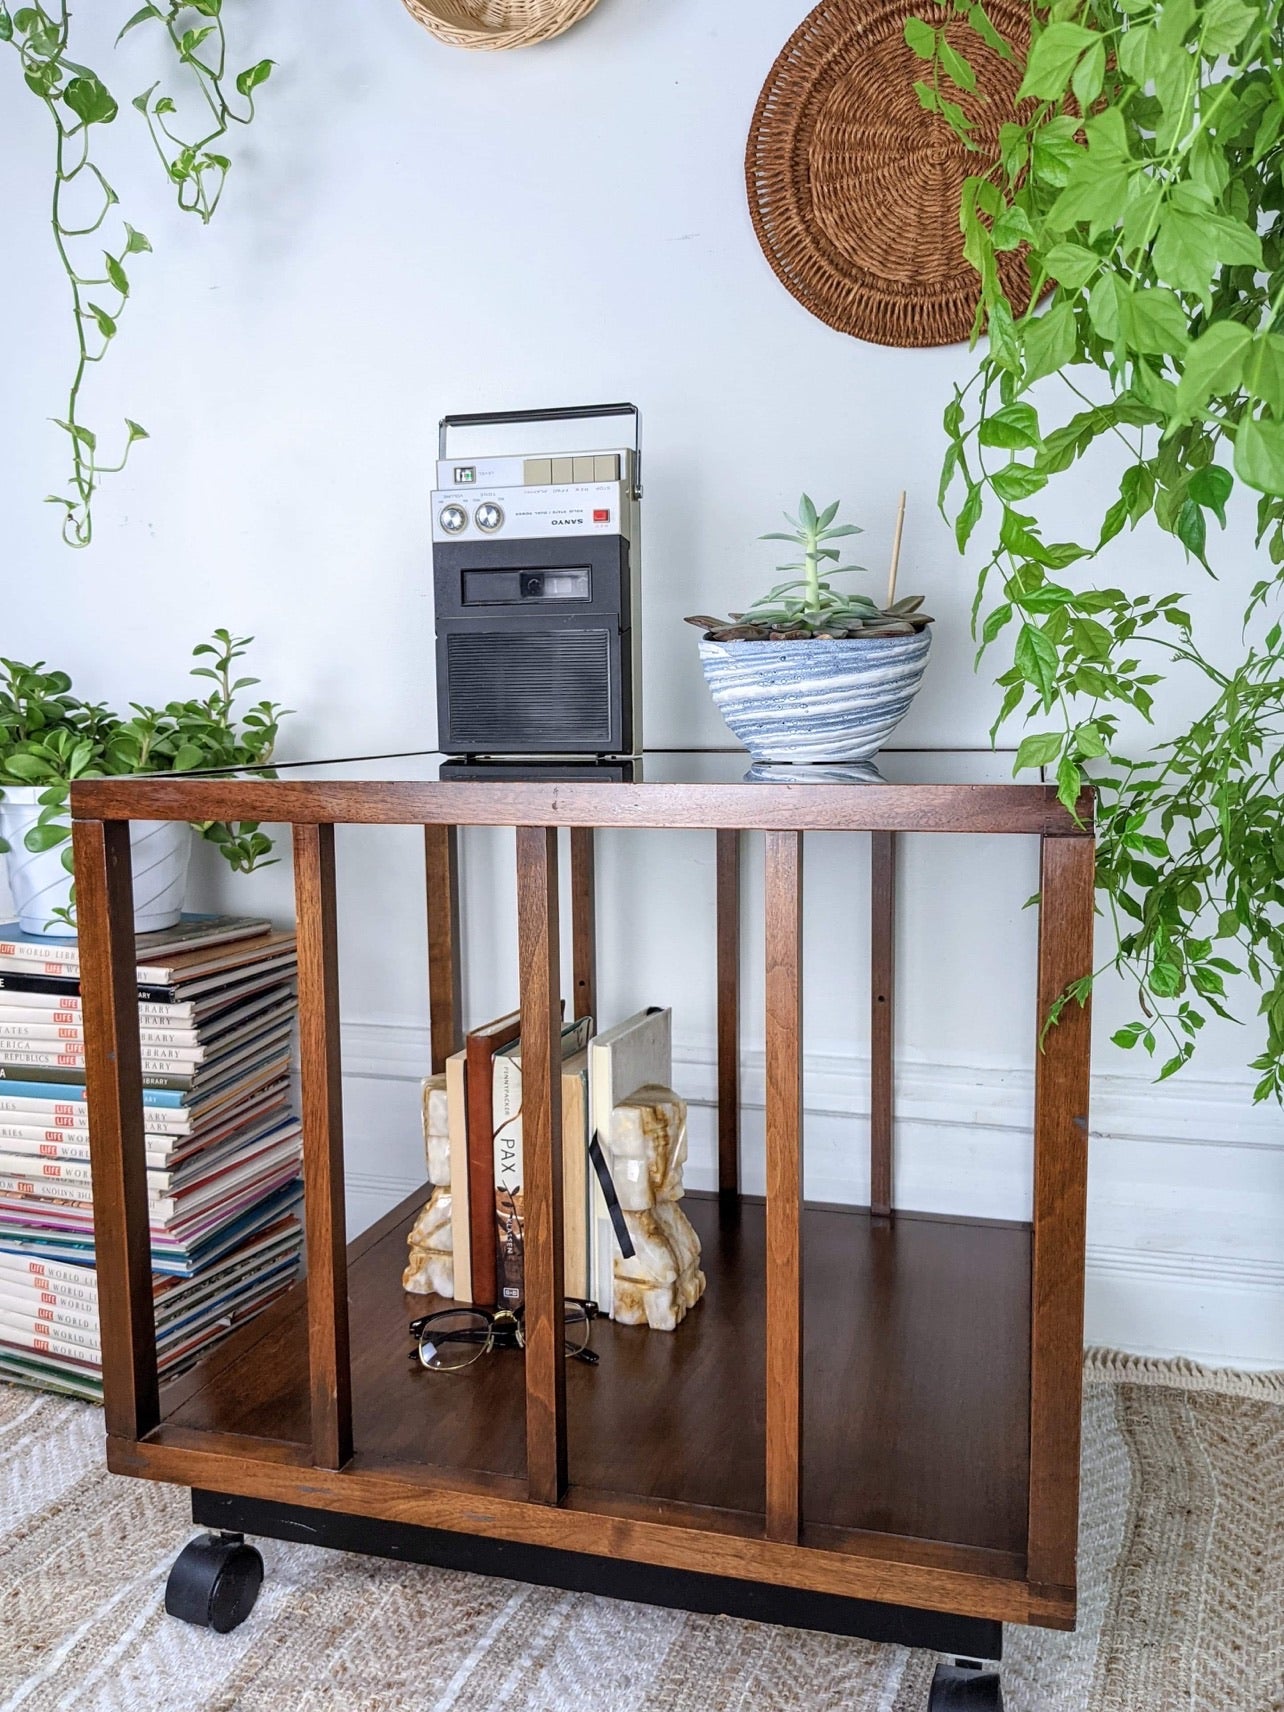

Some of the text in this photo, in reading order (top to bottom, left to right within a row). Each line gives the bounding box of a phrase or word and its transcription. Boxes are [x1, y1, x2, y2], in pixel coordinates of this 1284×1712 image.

[0, 944, 75, 960] LIFE WORLD LIBR
[45, 962, 62, 974] LIFE
[61, 999, 78, 1009] LIFE
[54, 1013, 73, 1023] LIFE
[59, 1028, 78, 1038] LIFE
[141, 1033, 175, 1043] BRARY
[0, 1040, 31, 1049] ERICA
[65, 1043, 84, 1053] LIFE
[4, 1053, 171, 1071] REPUBLICS LIFE RARY
[503, 1066, 511, 1116] PENNYPACKER
[55, 1104, 74, 1115] LIFE
[55, 1116, 74, 1127] LIFE
[2, 1129, 23, 1137] RIES
[45, 1131, 64, 1142] LIFE
[39, 1144, 89, 1157] LIFE WORL
[500, 1137, 516, 1174] PAX
[43, 1165, 88, 1178] LIFE WOR
[18, 1182, 34, 1194] LIFE
[41, 1187, 74, 1198] NATIONS
[29, 1262, 45, 1275] LIFE
[48, 1268, 79, 1282] WORLD
[34, 1277, 50, 1290] LIFE
[53, 1284, 83, 1297] WORLD
[41, 1292, 92, 1312] LIFE WORLD
[38, 1308, 54, 1321] LIFE
[57, 1313, 89, 1328] WORLD
[34, 1322, 50, 1335] LIFE
[53, 1329, 85, 1343] WORLD
[33, 1338, 85, 1358] LIFE WORLD
